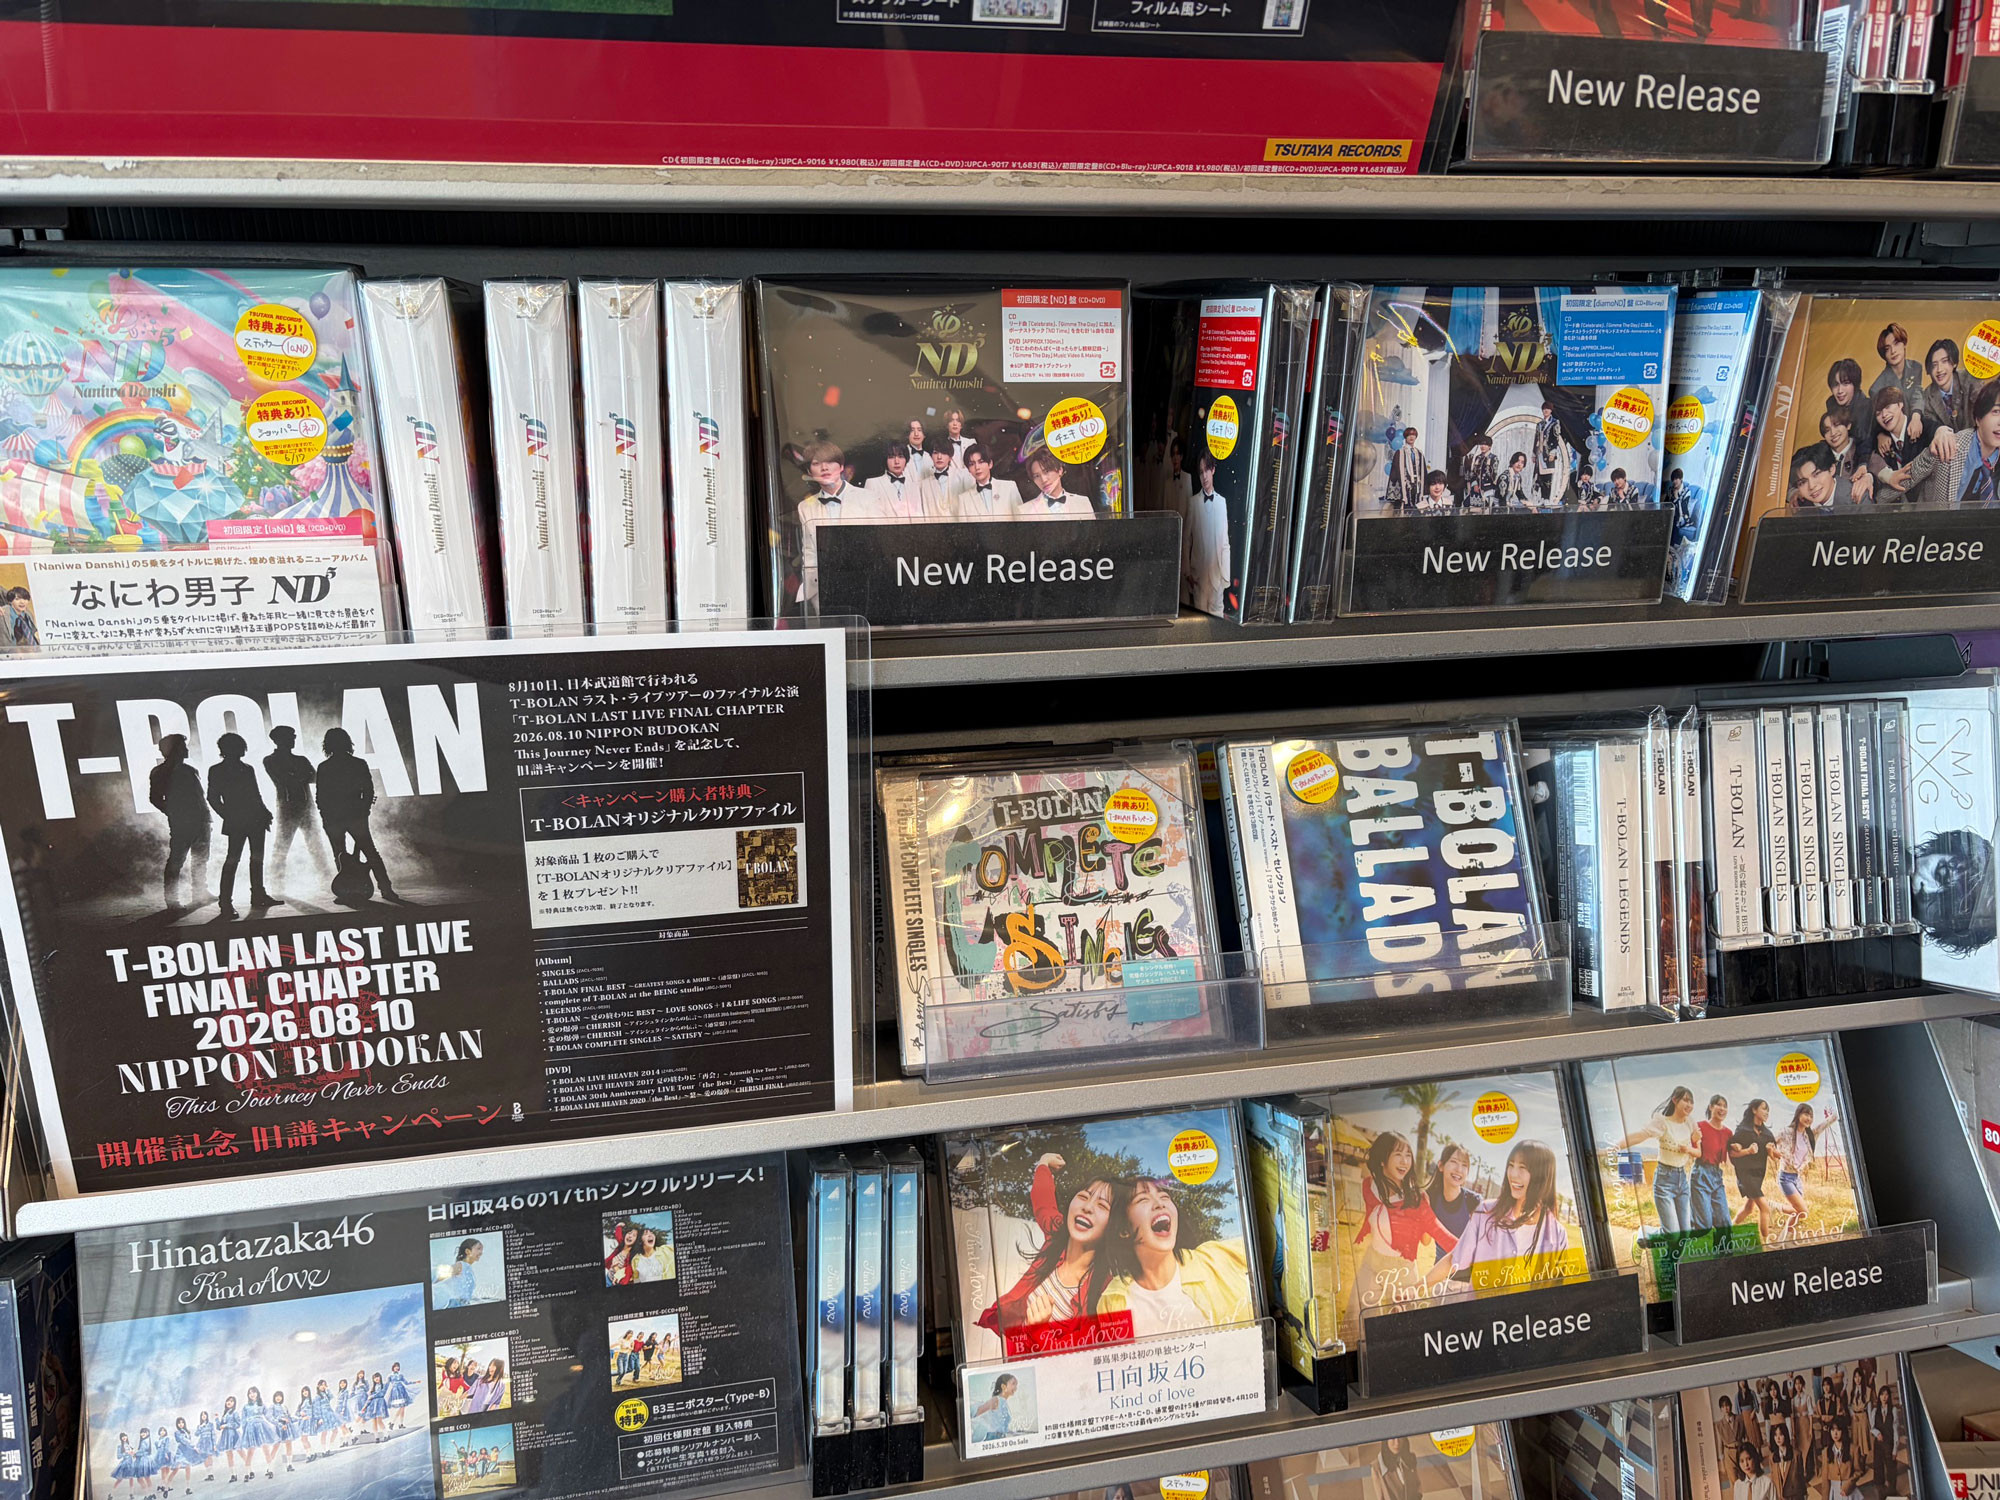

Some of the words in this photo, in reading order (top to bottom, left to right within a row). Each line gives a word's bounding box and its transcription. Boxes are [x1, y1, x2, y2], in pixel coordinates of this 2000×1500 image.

[1131, 1, 1232, 17] フィルム風シート
[1549, 69, 1625, 106] New
[1635, 74, 1761, 115] Release
[1274, 143, 1333, 158] TSUTAYA
[248, 319, 303, 337] 特典あり!
[73, 383, 126, 398] Naniwa
[128, 383, 177, 398] Danshi
[910, 378, 948, 390] Naniwa
[949, 377, 984, 389] Danshi
[1485, 374, 1517, 385] Naniwa
[1518, 373, 1547, 384] Danshi
[257, 405, 312, 421] 特典あり!
[1051, 407, 1093, 430] 特典あり!
[1614, 398, 1649, 417] 特典あり!
[1421, 545, 1491, 574] New
[1500, 540, 1612, 572] Release
[1811, 540, 1877, 567] New
[1881, 535, 1985, 565] Release
[896, 556, 974, 587] New
[986, 551, 1115, 584] Release
[70, 576, 255, 610] なにわ男子
[508, 673, 699, 693] 8月10日、日本武道館で行われる
[509, 696, 579, 710] T-BOLAN
[582, 685, 800, 707] ラスト・ライブツアーのファイナル公演
[512, 712, 588, 726] 「T-BOLAN
[590, 711, 628, 724] LAST
[632, 709, 665, 721] LIVE
[669, 706, 713, 719] FINAL
[716, 703, 785, 717] CHAPTER
[512, 730, 583, 744] 2026.08.10
[586, 726, 644, 740] NIPPON
[648, 722, 721, 737] BUDOKAN
[5, 682, 488, 820] T-BOLAN
[514, 748, 541, 761] This
[543, 745, 592, 761] Journey
[594, 743, 632, 756] Never
[516, 757, 664, 777] 旧譜キャンペーンを開催!
[1858, 736, 1868, 770] T-BOLAN
[1656, 749, 1666, 796] T-BOLAN
[1686, 749, 1696, 797] T-BOLAN
[1828, 754, 1843, 823] T-BOLAN
[1860, 770, 1869, 796] FINAL
[1886, 757, 1896, 794] T-BOLAN
[997, 788, 1108, 821] T-BOLAN
[1113, 800, 1149, 811] 特典あり!
[1729, 764, 1746, 849] T-BOLAN
[1771, 758, 1785, 827] T-BOLAN
[1800, 759, 1814, 828] T-BOLAN
[531, 801, 797, 833] T-BOLANオリジナルクリアファイル
[1862, 797, 1870, 821] BEST
[1257, 747, 1271, 788] T-BOLAN
[1264, 790, 1287, 904] バラード・ベスト・セレクション
[1615, 797, 1628, 869] T-BOLAN
[536, 860, 733, 885] 【T-BOLANオリジナルクリアファイル】
[1336, 736, 1453, 999] BALLADS
[1424, 729, 1541, 991] T-BOLAN
[1774, 835, 1788, 902] SINGLES
[1803, 835, 1817, 902] SINGLES
[1832, 830, 1846, 898] SINGLES
[900, 851, 923, 917] COMPLETE
[1231, 864, 1251, 948] BALLADS
[1618, 877, 1631, 955] LEGENDS
[658, 929, 690, 939] 対象商品
[906, 917, 926, 974] SINGLES
[106, 934, 282, 983] T-BOLAN
[291, 927, 384, 965] LAST
[393, 919, 474, 955] LIVE
[535, 955, 572, 968] [Album]
[142, 974, 258, 1018] FINAL
[266, 959, 441, 1006] CHAPTER
[544, 997, 581, 1006] complete
[582, 995, 591, 1003] of
[592, 992, 627, 1002] T-BOLAN
[639, 990, 652, 998] the
[653, 988, 679, 997] BEING
[680, 985, 704, 994] studio
[192, 997, 417, 1051] 2026.08.10
[545, 1006, 582, 1016] LEGENDS
[546, 1015, 581, 1025] T-BOLAN
[636, 1009, 656, 1017] BEST
[665, 1006, 687, 1015] LOVE
[687, 1002, 714, 1012] SONGS
[733, 999, 750, 1008] LIFE
[751, 996, 777, 1006] SONGS
[115, 1046, 280, 1095] NIPPON
[293, 1028, 485, 1077] BUDOKAN
[545, 1065, 571, 1076] [DVD]
[552, 1077, 586, 1086] T-BOLAN
[587, 1074, 606, 1083] LIVE
[608, 1071, 639, 1080] HEAVEN
[641, 1069, 660, 1077] 2014
[1780, 1062, 1812, 1073] 特典あり!
[165, 1095, 221, 1121] This
[225, 1088, 318, 1116] Journey
[321, 1081, 387, 1106] Never
[391, 1071, 450, 1097] Ends
[1477, 1102, 1510, 1114] 特典あり!
[97, 1127, 240, 1169] 開催記念
[251, 1104, 503, 1154] 旧譜キャンペーン
[1174, 1140, 1209, 1152] 特典あり!
[128, 1212, 375, 1274] Hinatazaka46
[1657, 1246, 1669, 1259] D
[178, 1270, 245, 1305] Kind
[1361, 1268, 1430, 1308] Kind
[1478, 1275, 1489, 1287] C
[1730, 1277, 1786, 1307] New
[1793, 1263, 1884, 1296] Release
[1015, 1342, 1025, 1353] B
[1422, 1326, 1484, 1358] New
[1492, 1311, 1593, 1346] Release
[1092, 1341, 1207, 1367] 藤嶌果歩は初の単独センター!
[1096, 1355, 1206, 1394] 日向坂46
[652, 1387, 771, 1415] B3ミニポスター(Type-B)
[1109, 1393, 1145, 1410] Kind
[1148, 1391, 1164, 1404] of
[1167, 1386, 1196, 1400] love
[1, 1407, 16, 1440] BLUE
[619, 1414, 645, 1427] 特典
[643, 1425, 712, 1445] 初回仕様限定盤
[715, 1420, 753, 1433] 封入特典
[981, 1441, 1008, 1452] 2026.5.20
[1008, 1440, 1018, 1448] On
[1018, 1437, 1029, 1446] Sale
[1, 1449, 23, 1482] 景色
